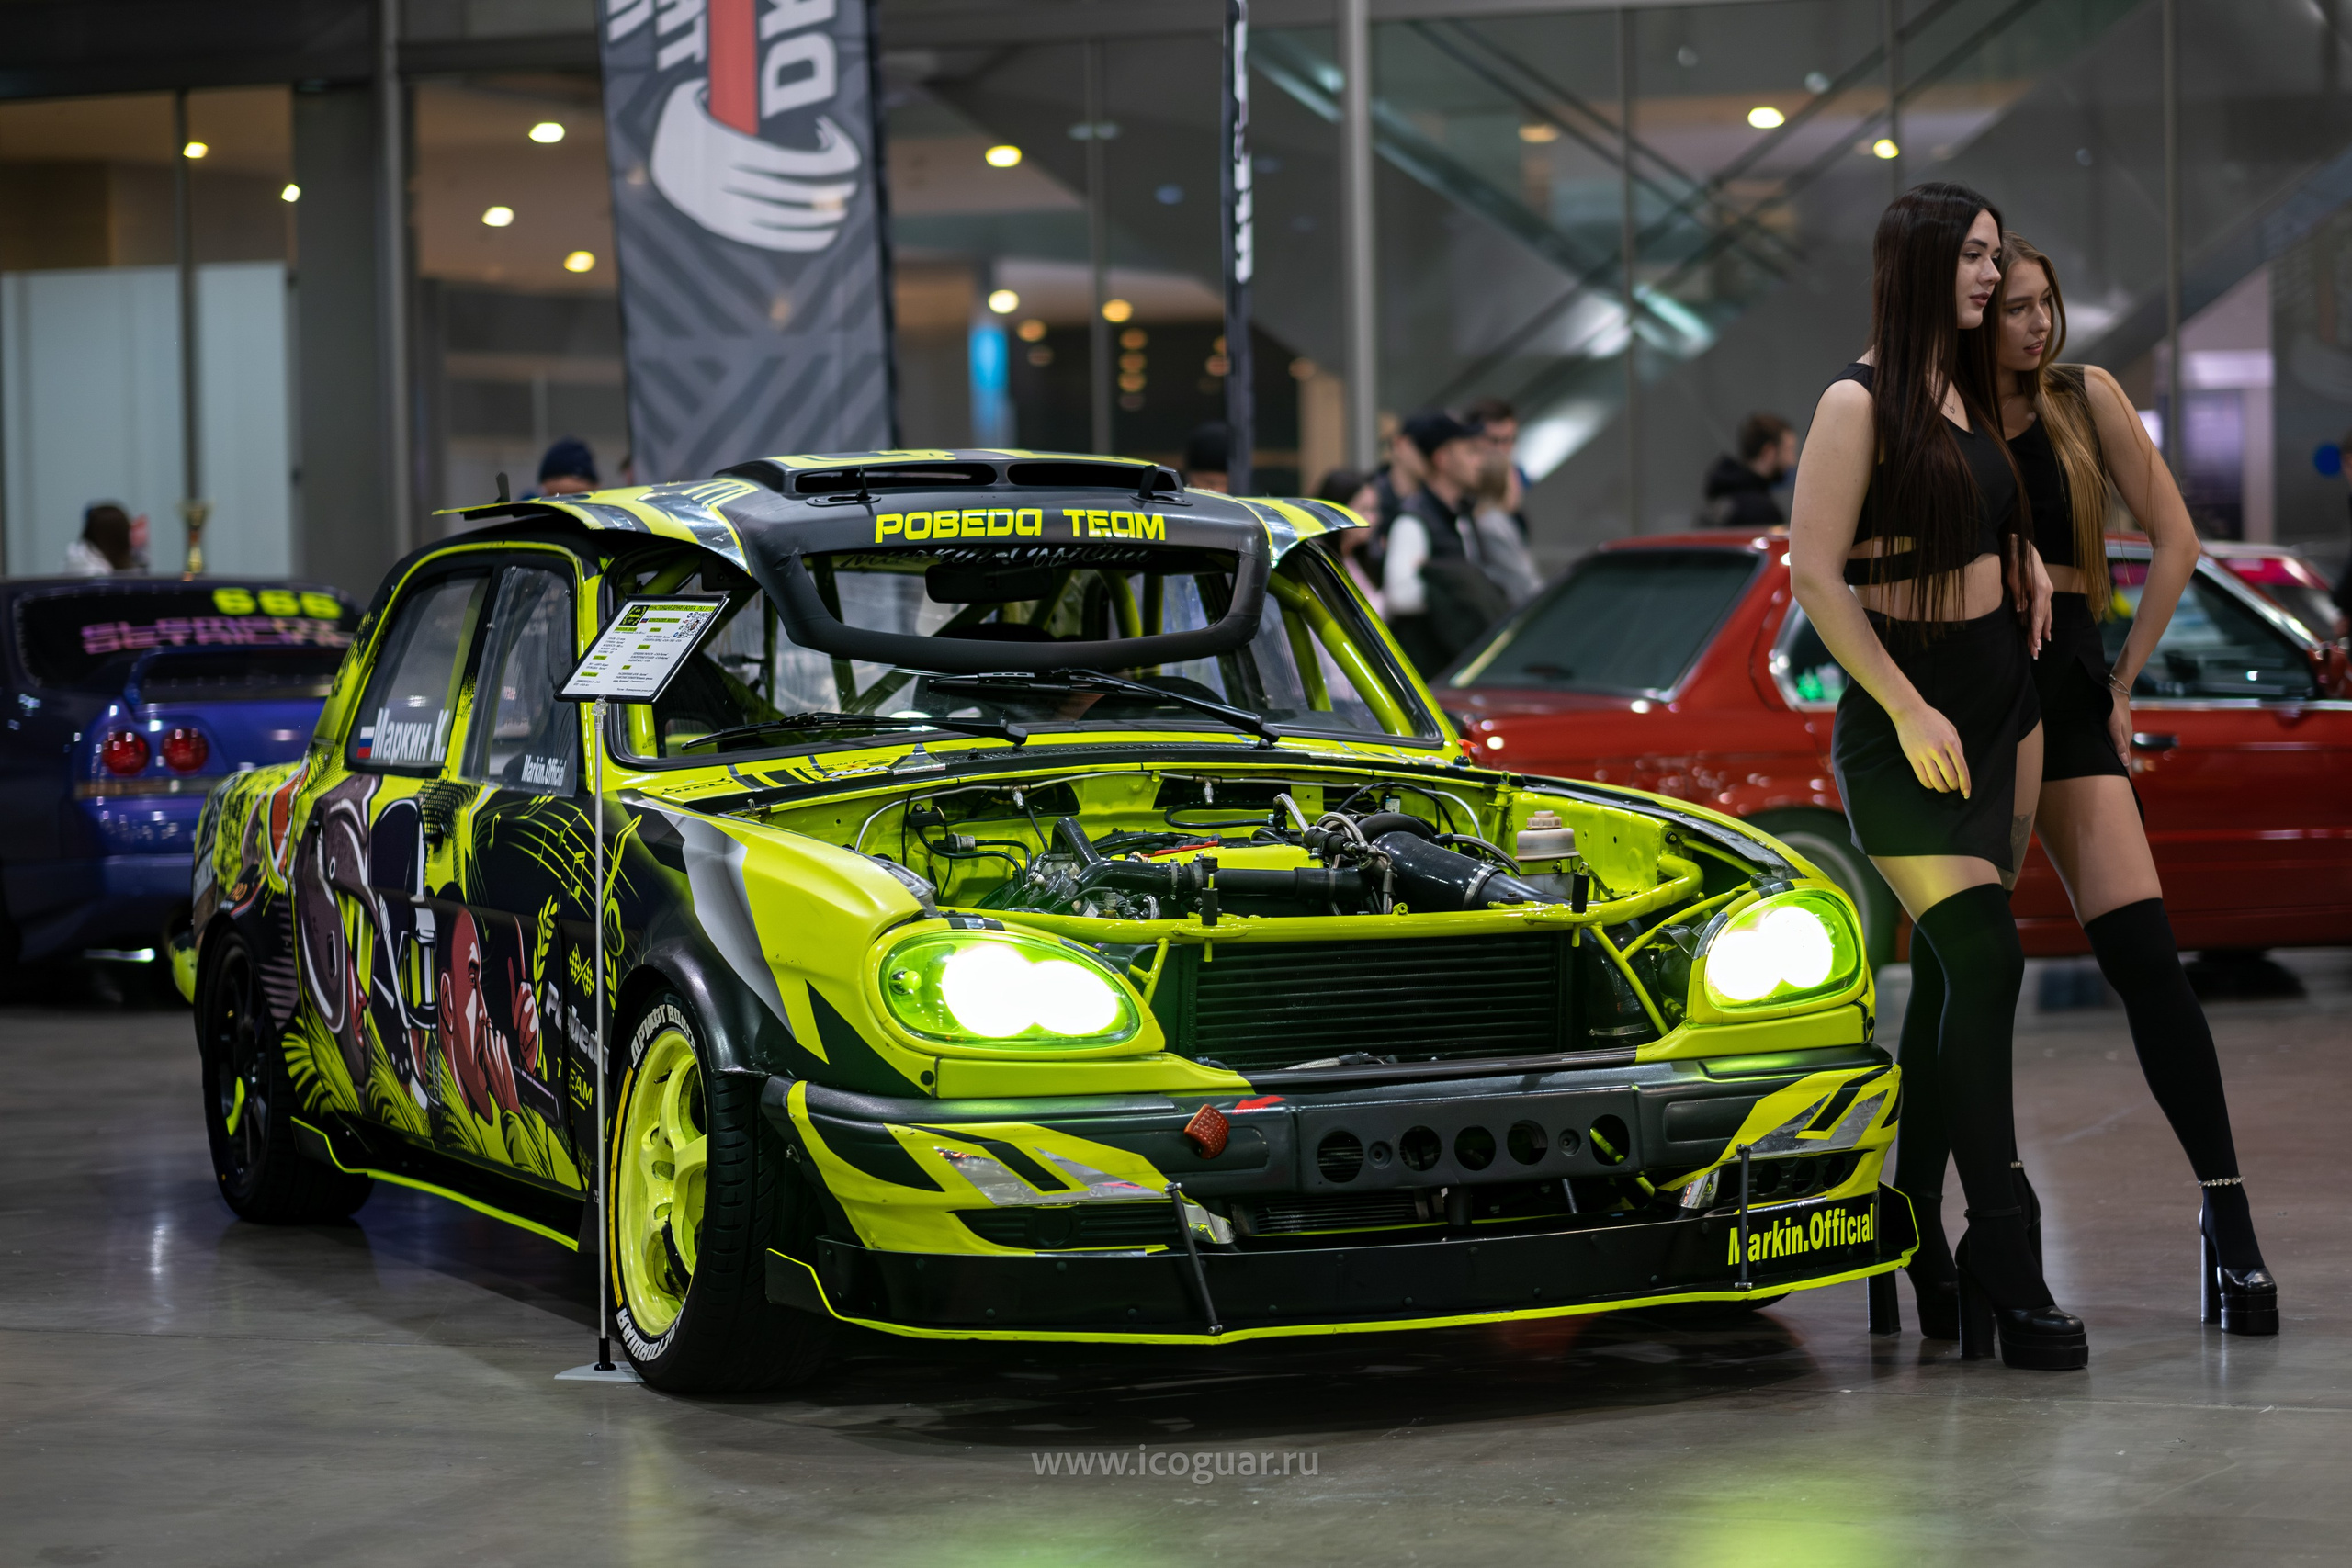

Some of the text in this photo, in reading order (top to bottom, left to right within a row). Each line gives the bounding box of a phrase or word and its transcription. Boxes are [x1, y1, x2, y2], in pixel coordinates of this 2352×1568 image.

[875, 508, 1166, 544] POBEDA TEAM
[370, 707, 432, 766] Маркин
[557, 1056, 594, 1106] TEAM
